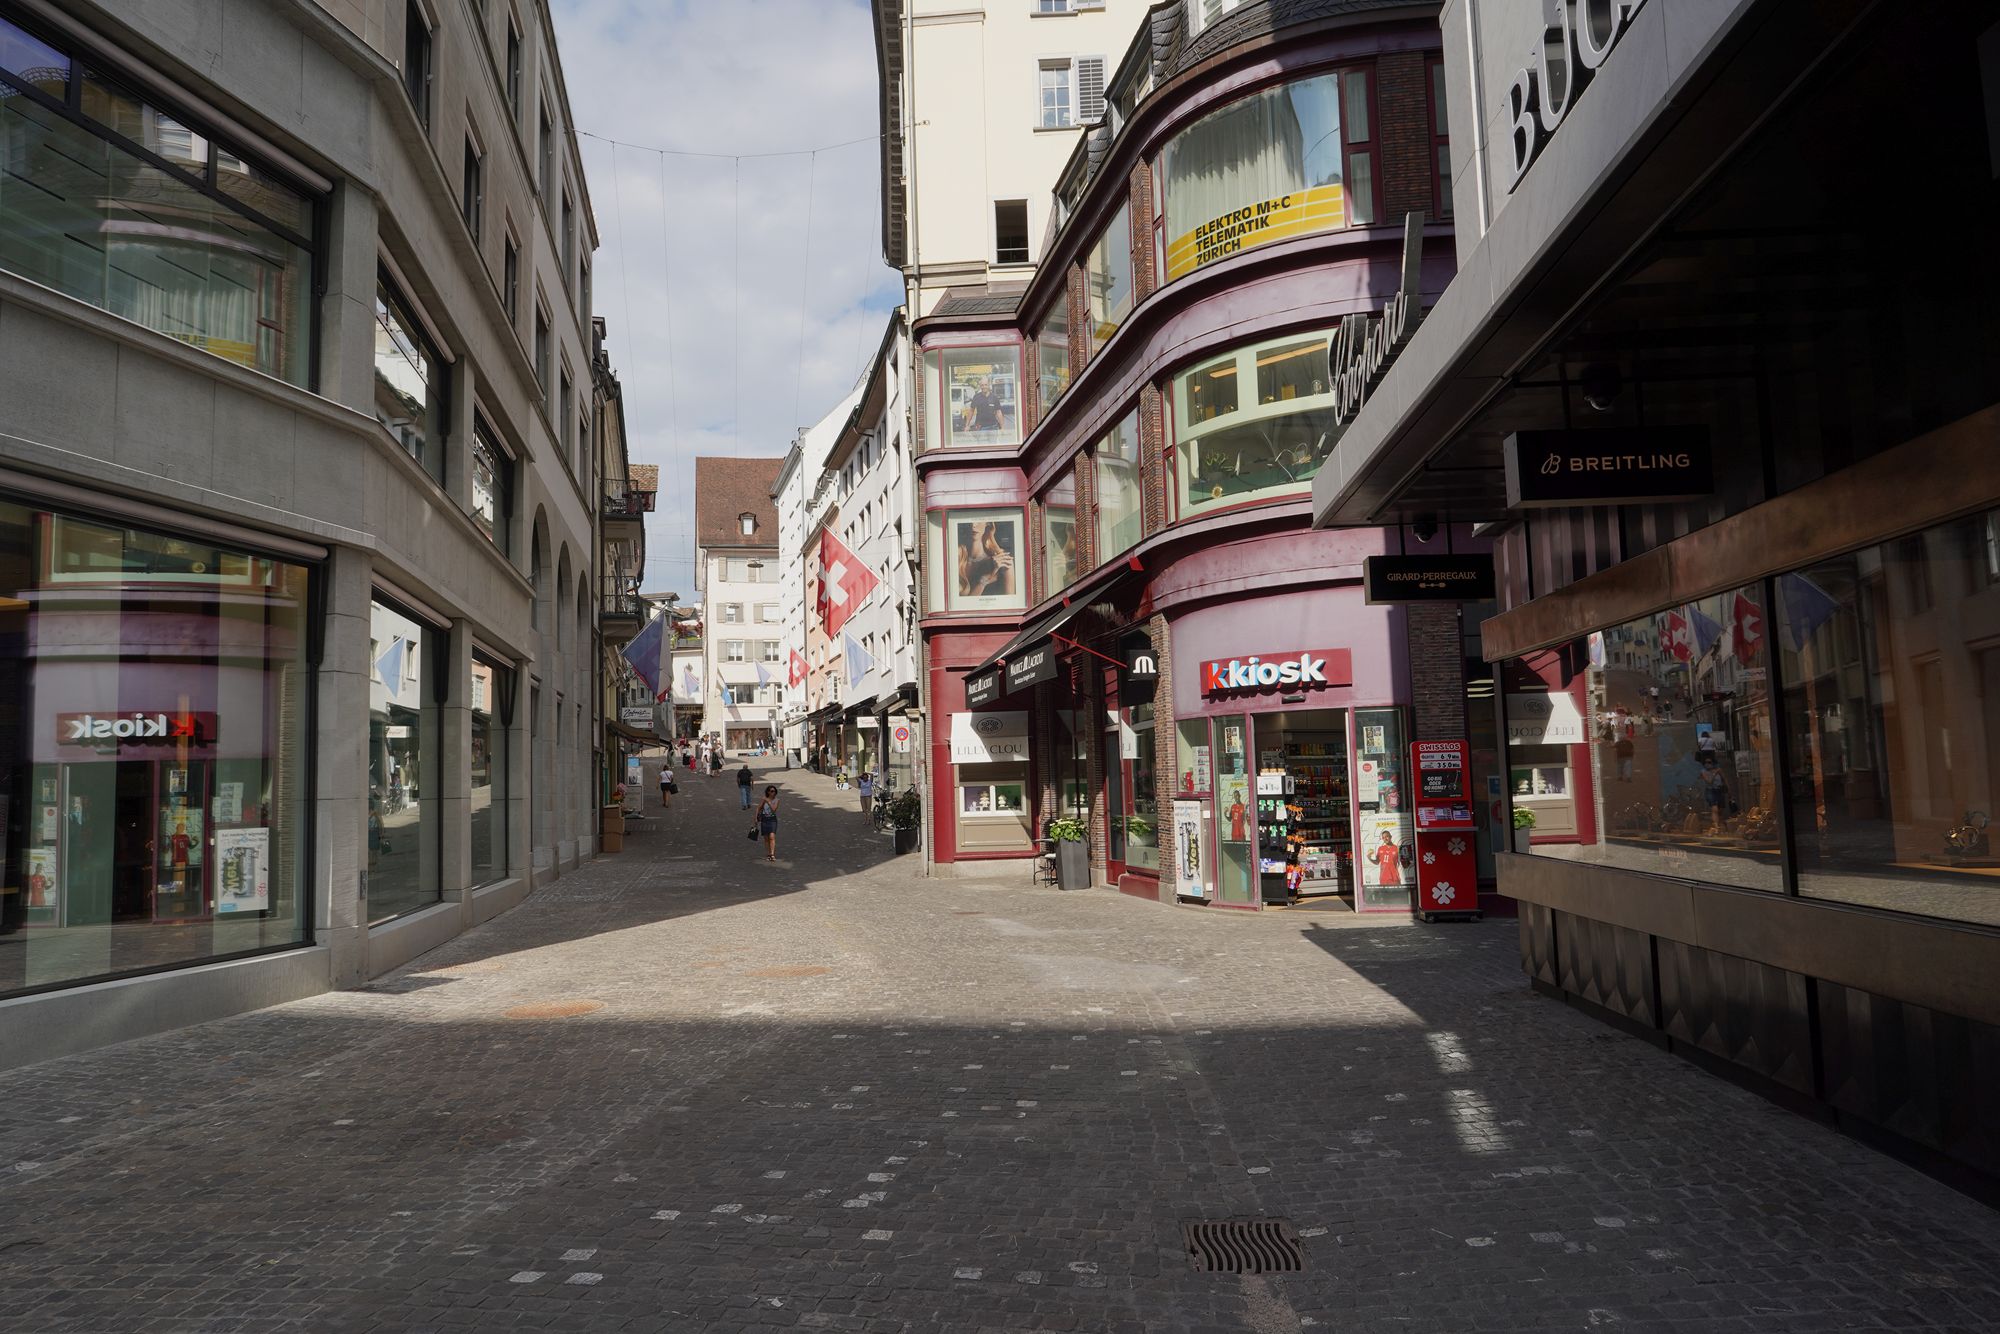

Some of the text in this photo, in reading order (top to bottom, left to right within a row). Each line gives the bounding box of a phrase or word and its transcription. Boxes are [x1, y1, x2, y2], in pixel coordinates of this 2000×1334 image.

[1195, 195, 1291, 240] ELEKTRO M+C
[1195, 215, 1270, 255] TELEMATIK
[1196, 238, 1241, 267] ZÜRICH
[1569, 453, 1691, 472] BREITLING
[1386, 571, 1477, 582] GIRARD-PERREGAUX
[957, 744, 1022, 755] LILLY CLOU
[1419, 743, 1461, 752] SWISSLOS
